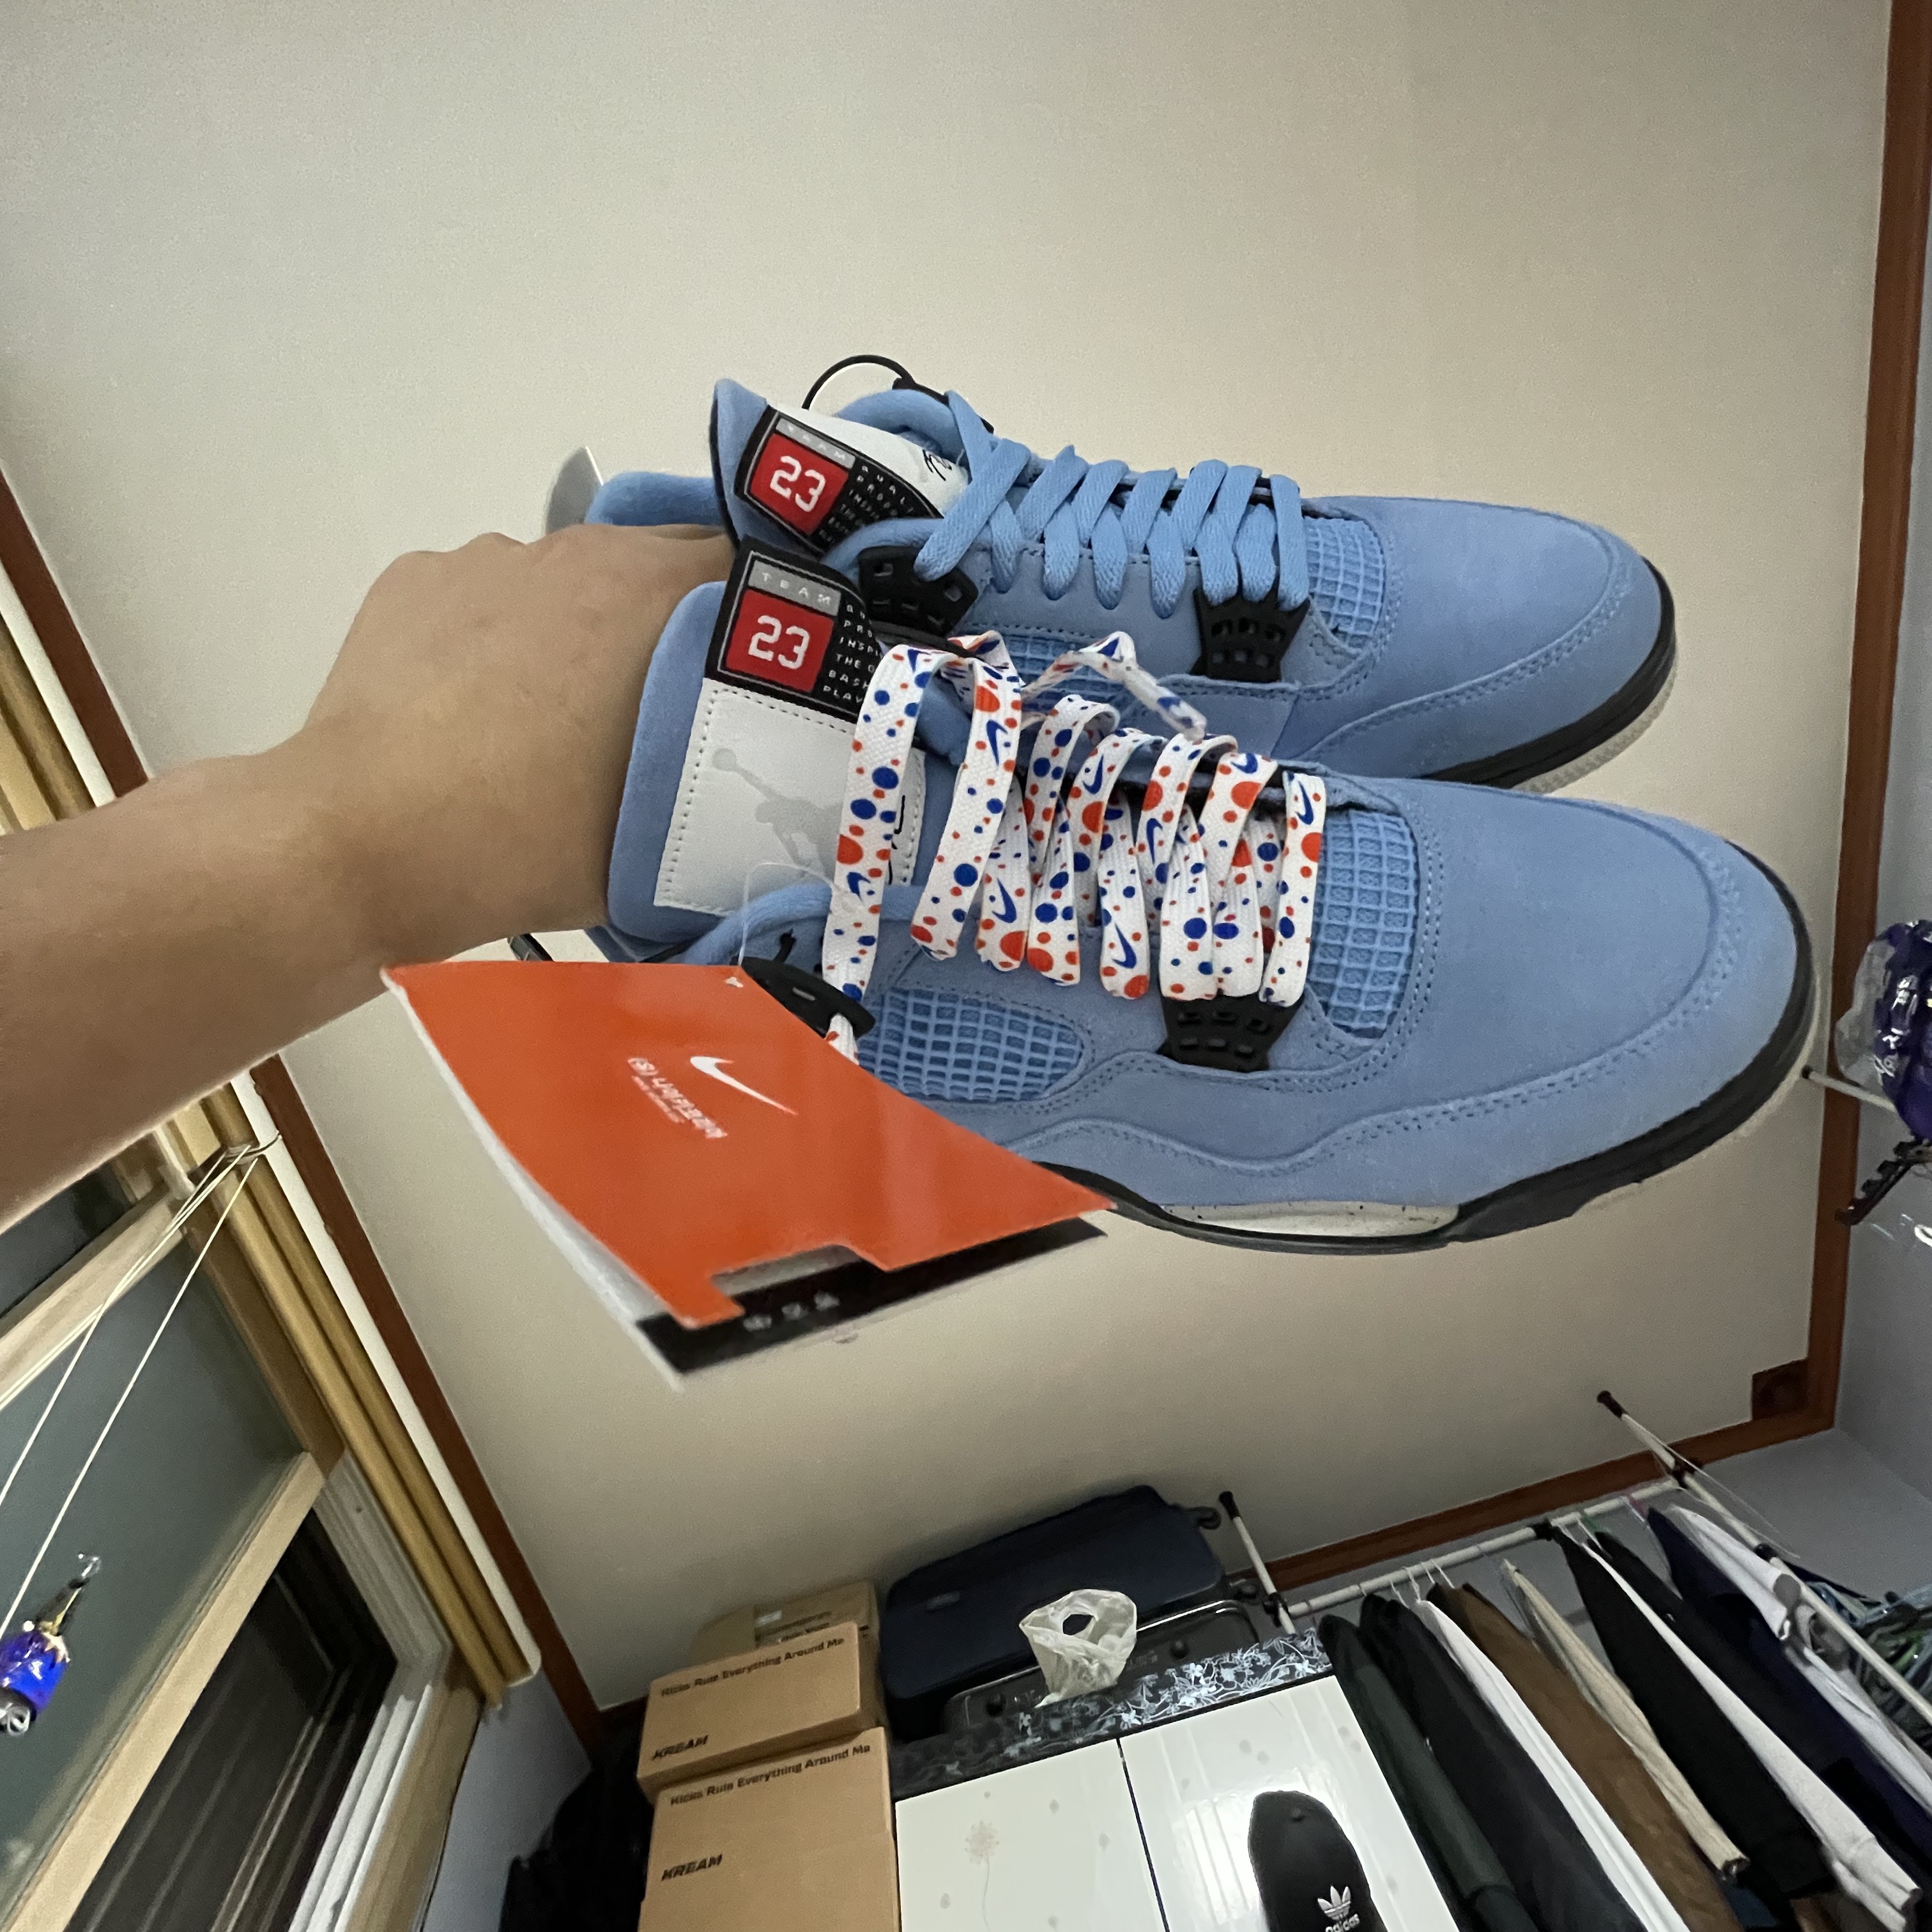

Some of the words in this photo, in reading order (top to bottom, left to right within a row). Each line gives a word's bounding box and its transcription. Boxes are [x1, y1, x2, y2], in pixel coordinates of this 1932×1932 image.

[769, 455, 826, 512] 23
[762, 572, 832, 606] TEAM
[747, 615, 810, 670] 23
[836, 653, 862, 669] THE
[783, 1641, 824, 1661] Around
[737, 1762, 803, 1788] Everything
[804, 1748, 849, 1769] Around
[852, 1744, 871, 1756] Me
[661, 1853, 723, 1882] KREAM
